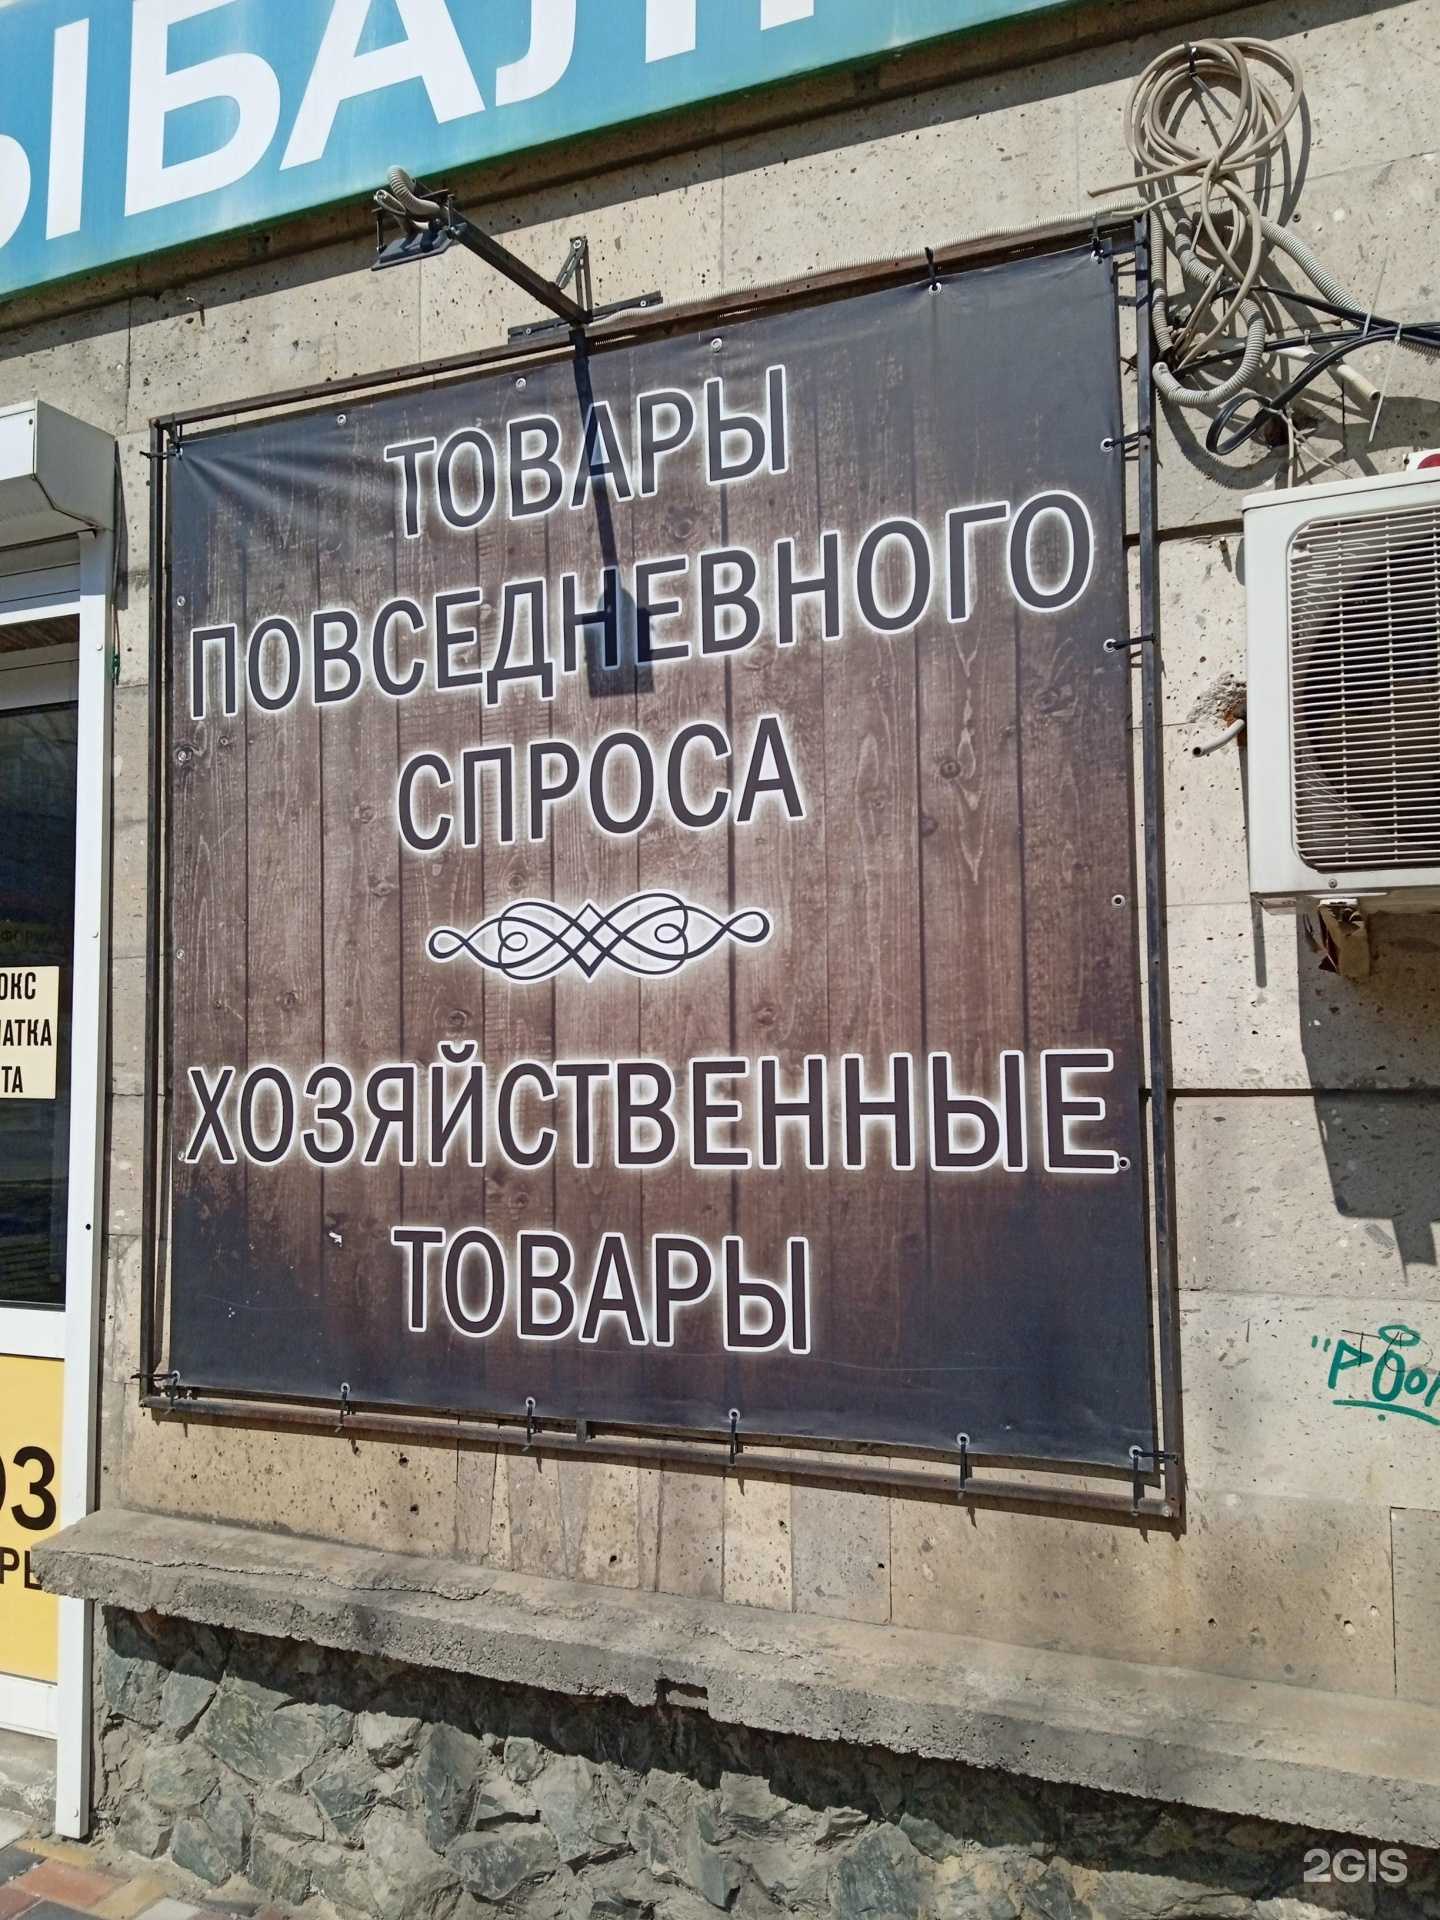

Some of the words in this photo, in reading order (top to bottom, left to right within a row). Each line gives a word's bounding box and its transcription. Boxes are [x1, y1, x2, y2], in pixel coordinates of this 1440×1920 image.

[386, 365, 785, 537] ТОВАРЫ
[191, 490, 1094, 720] ПОВСЕДНЕВНОГО
[399, 713, 806, 853] СПРОСА
[0, 1018, 52, 1046] АТКА
[185, 1040, 1120, 1174] ХОЗЯЙСТВЕННЫЕ
[391, 1226, 811, 1354] ТОВАРЫ
[0, 1445, 57, 1531] 3
